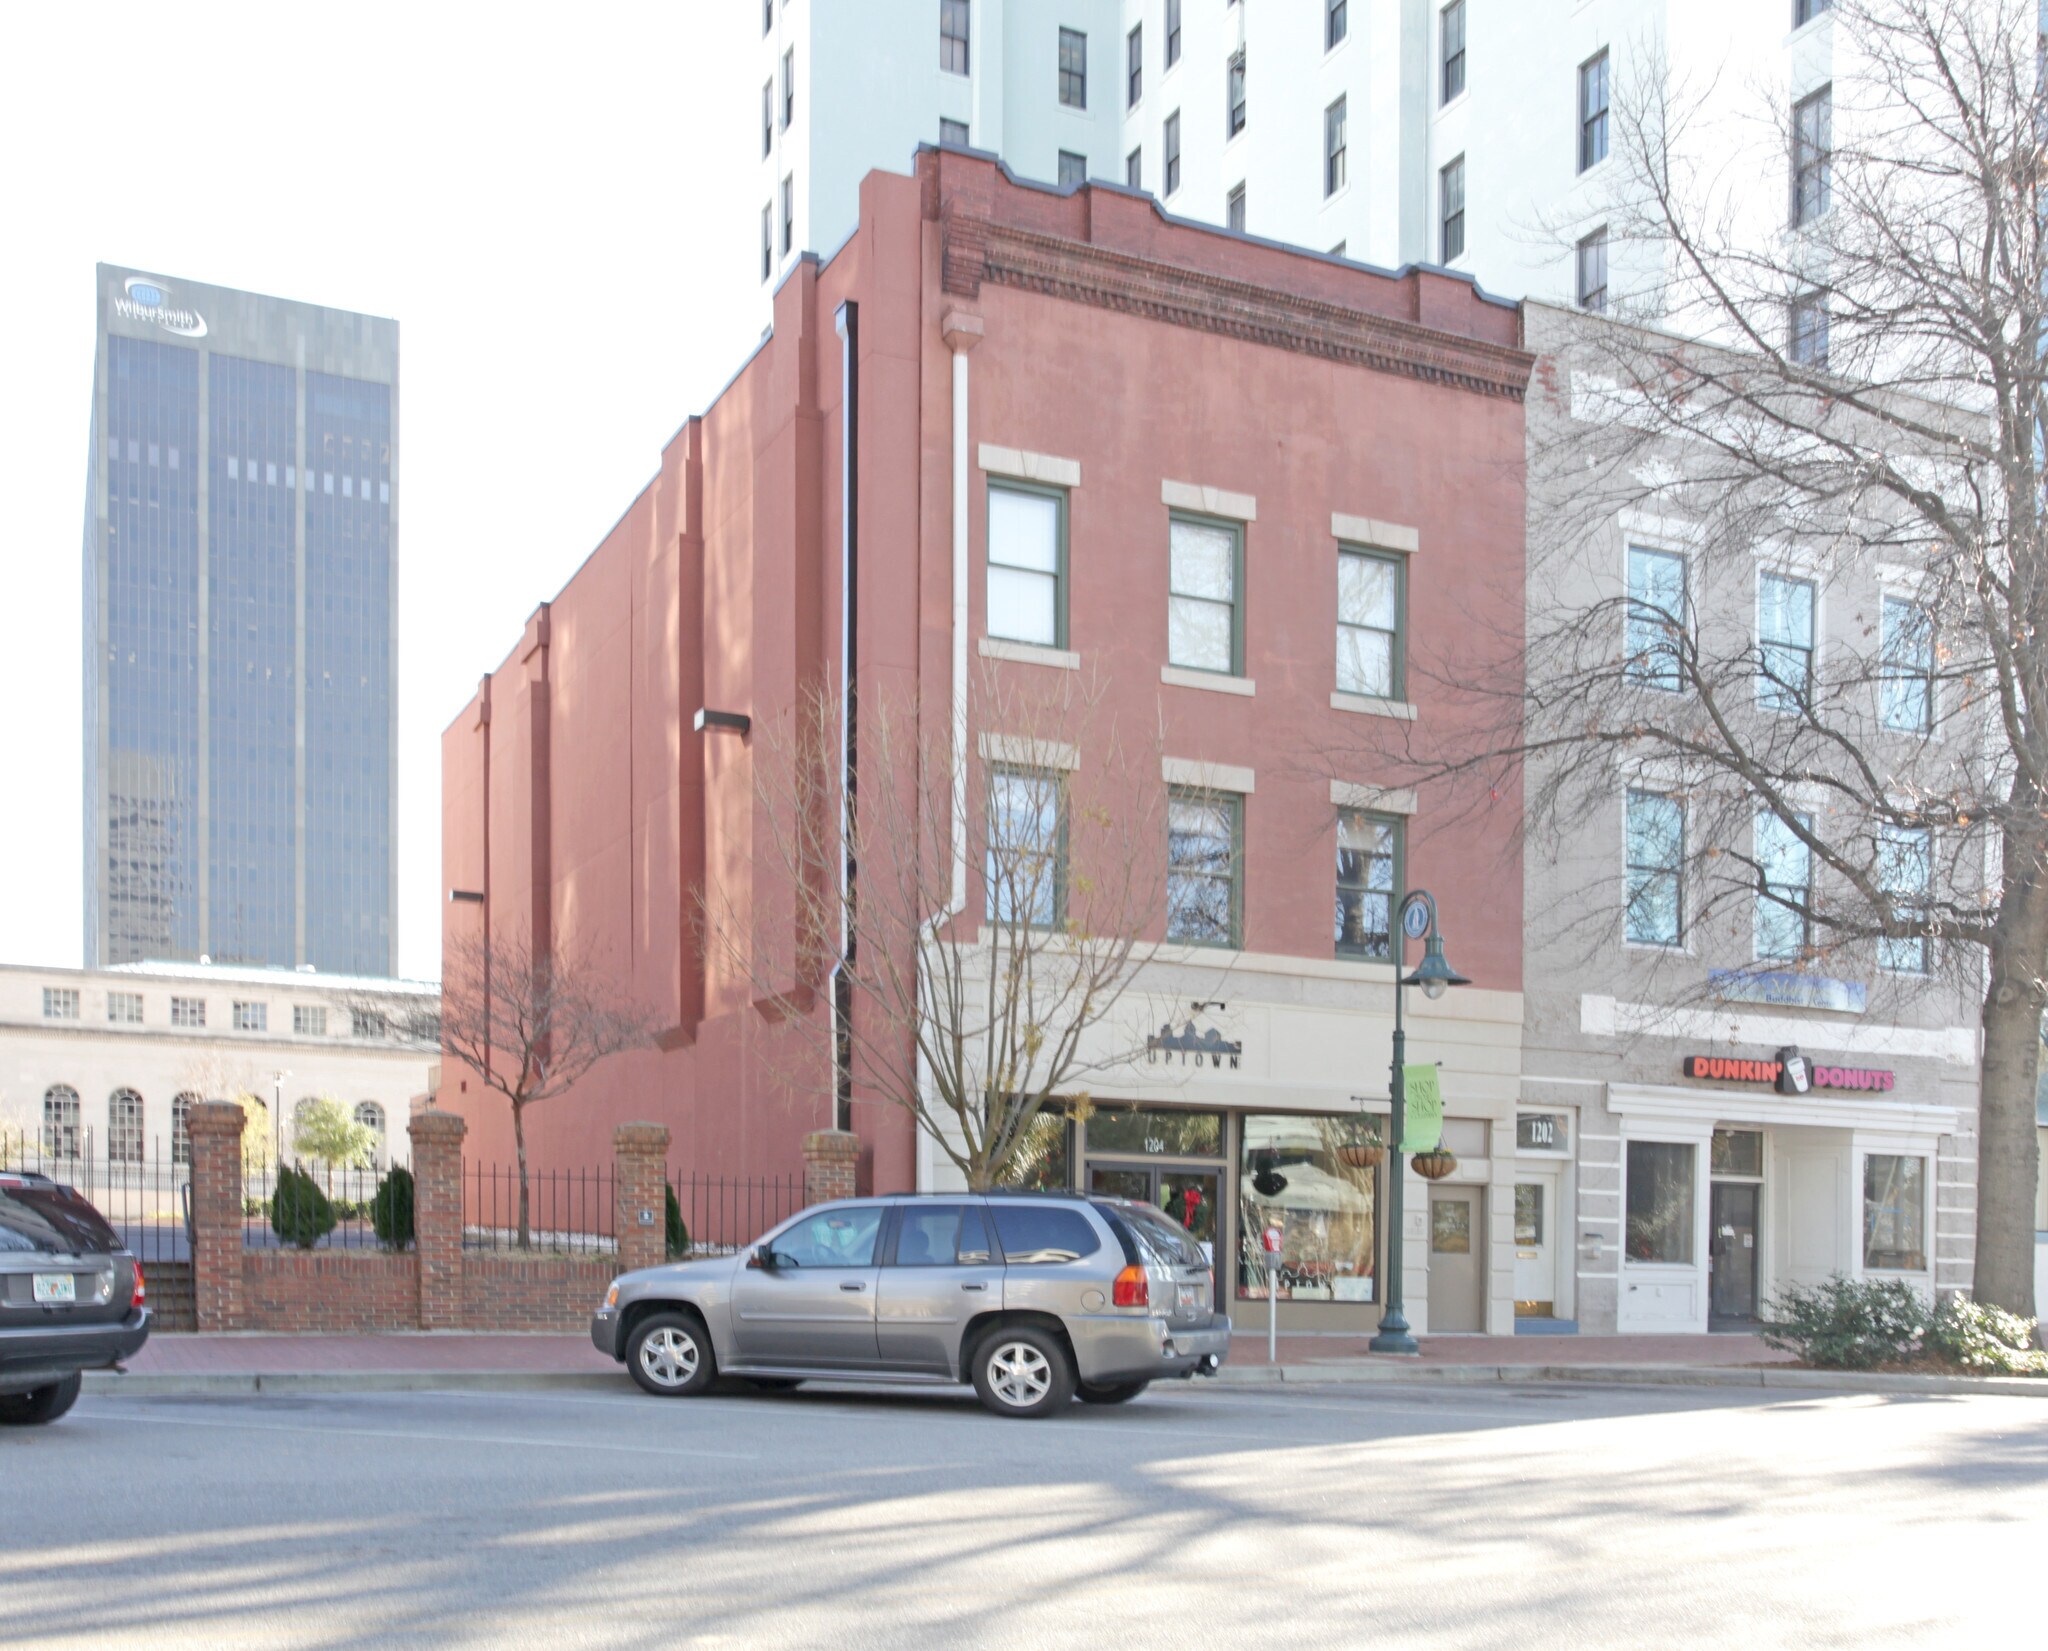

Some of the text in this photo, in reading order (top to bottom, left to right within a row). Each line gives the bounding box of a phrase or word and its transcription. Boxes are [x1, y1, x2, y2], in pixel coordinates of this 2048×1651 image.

[1148, 1048, 1238, 1069] UPTOWN
[1693, 1056, 1783, 1082] DUNKIN'
[1814, 1066, 1895, 1091] DONUTS
[1531, 1120, 1553, 1144] 1202
[1144, 1136, 1164, 1153] 1204
